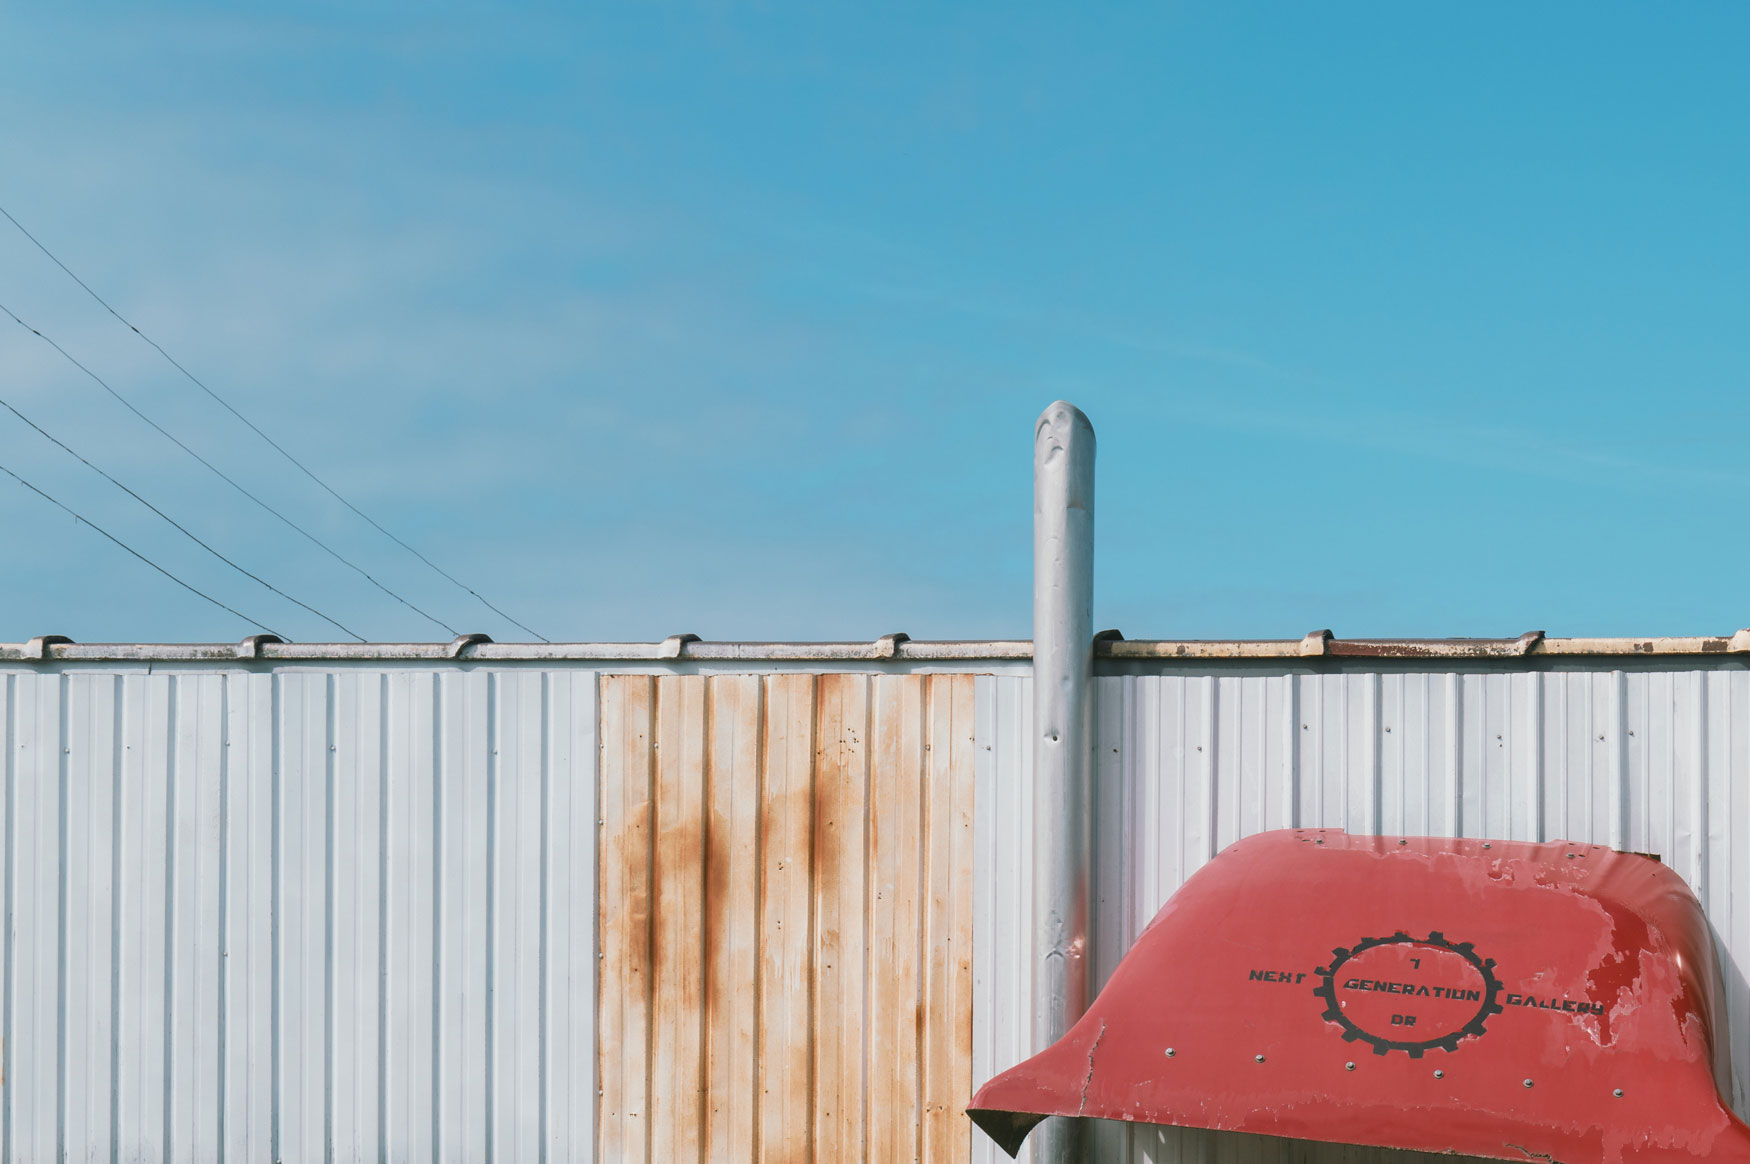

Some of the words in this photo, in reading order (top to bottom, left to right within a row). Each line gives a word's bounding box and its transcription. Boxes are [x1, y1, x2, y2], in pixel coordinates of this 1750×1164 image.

[1249, 969, 1307, 985] NEXT
[1343, 978, 1481, 1002] GENERATION
[1505, 993, 1605, 1016] GALLERY
